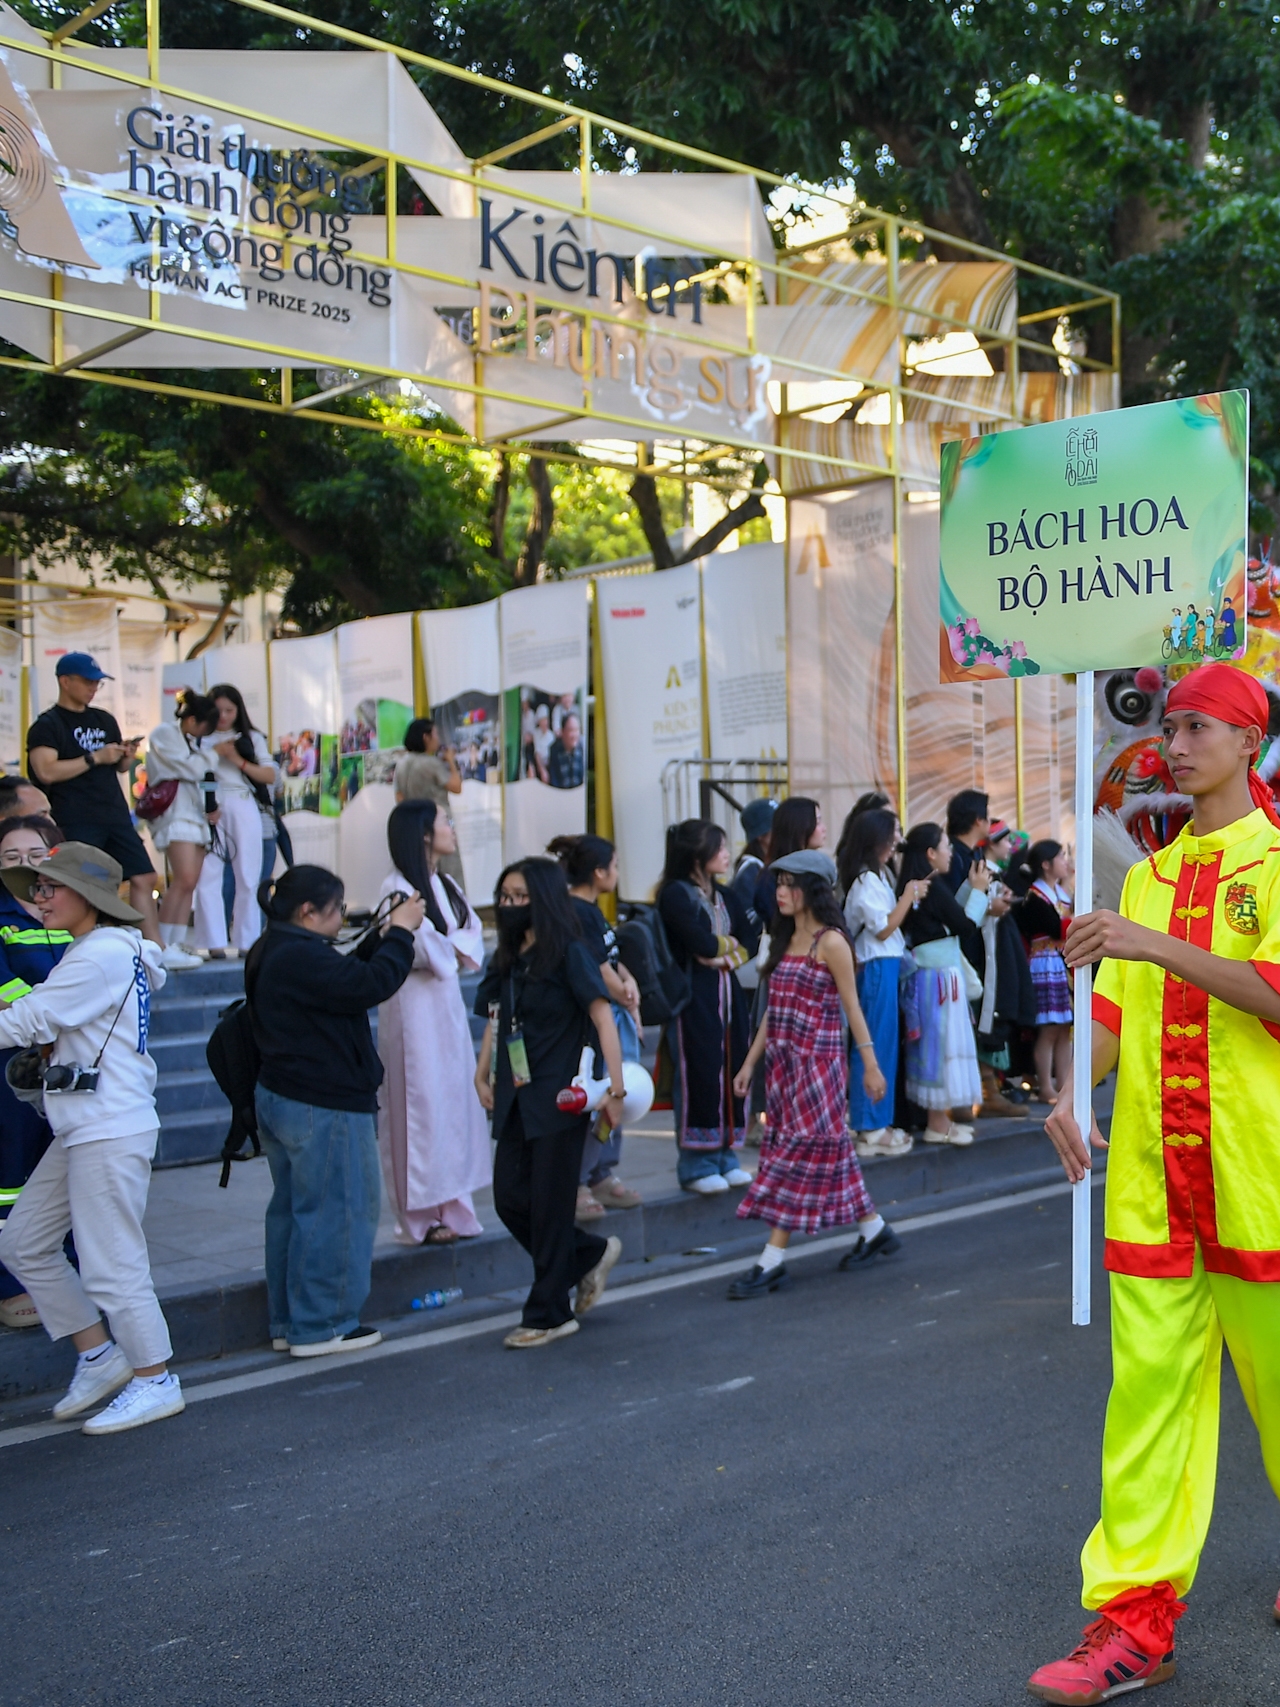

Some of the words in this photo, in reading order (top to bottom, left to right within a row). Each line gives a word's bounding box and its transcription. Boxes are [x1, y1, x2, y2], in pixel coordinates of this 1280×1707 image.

[127, 106, 211, 163] Giải
[219, 133, 368, 214] thưởng
[128, 149, 239, 216] hành
[250, 186, 352, 253] động
[129, 205, 168, 248] vì
[178, 218, 285, 282] cộng
[293, 243, 392, 308] đồng
[130, 262, 209, 293] HUMAN
[214, 281, 252, 301] ACT
[257, 289, 307, 314] PRIZE
[311, 302, 351, 323] 2025
[479, 197, 624, 305] Kiên
[478, 280, 684, 410] Phụng
[987, 508, 1088, 557] BÁCH
[1098, 495, 1189, 541] HOA
[997, 564, 1048, 616] BỘ
[1059, 556, 1174, 604] HÀNH
